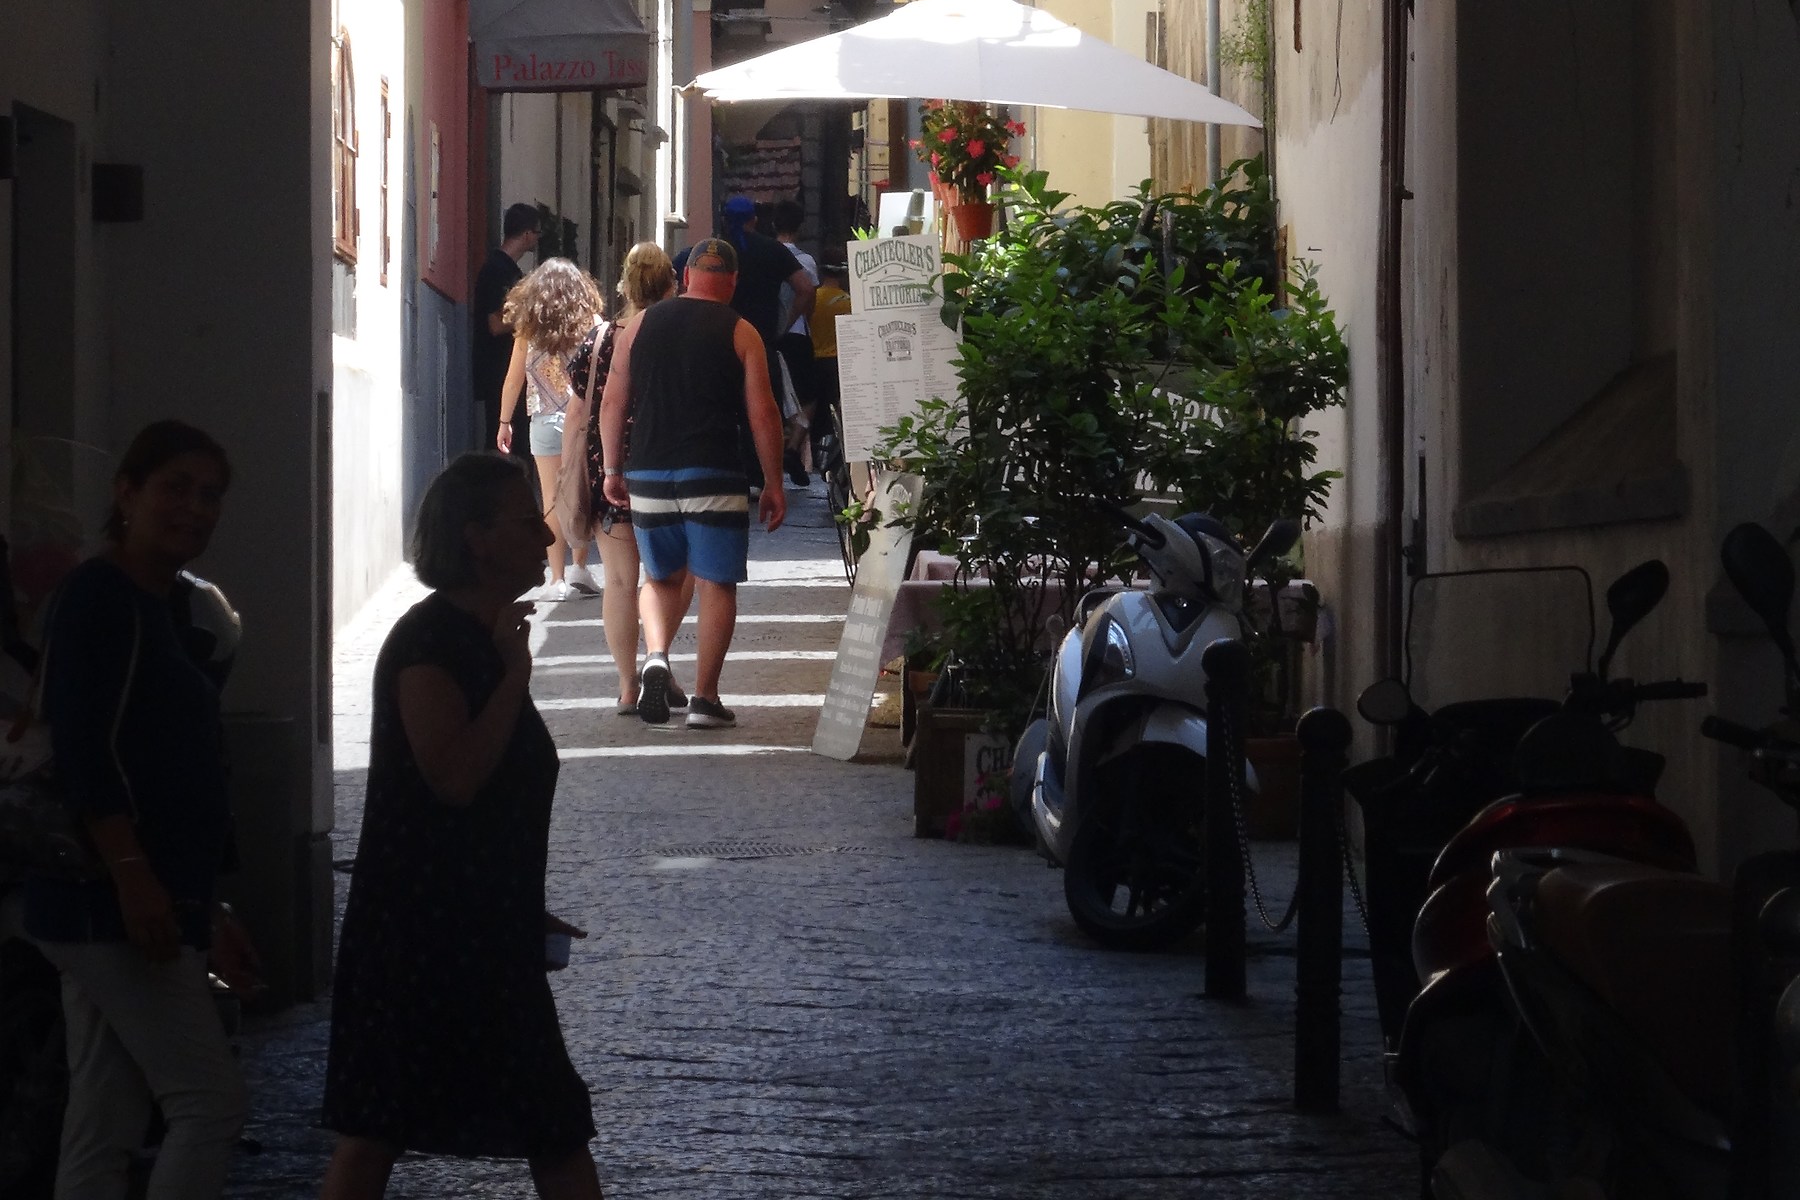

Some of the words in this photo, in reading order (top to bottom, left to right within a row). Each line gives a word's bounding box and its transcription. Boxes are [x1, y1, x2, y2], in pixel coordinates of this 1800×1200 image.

[494, 53, 595, 81] Palazzo
[855, 240, 934, 279] CHANTECLER'S
[869, 284, 924, 307] TRATTORIA
